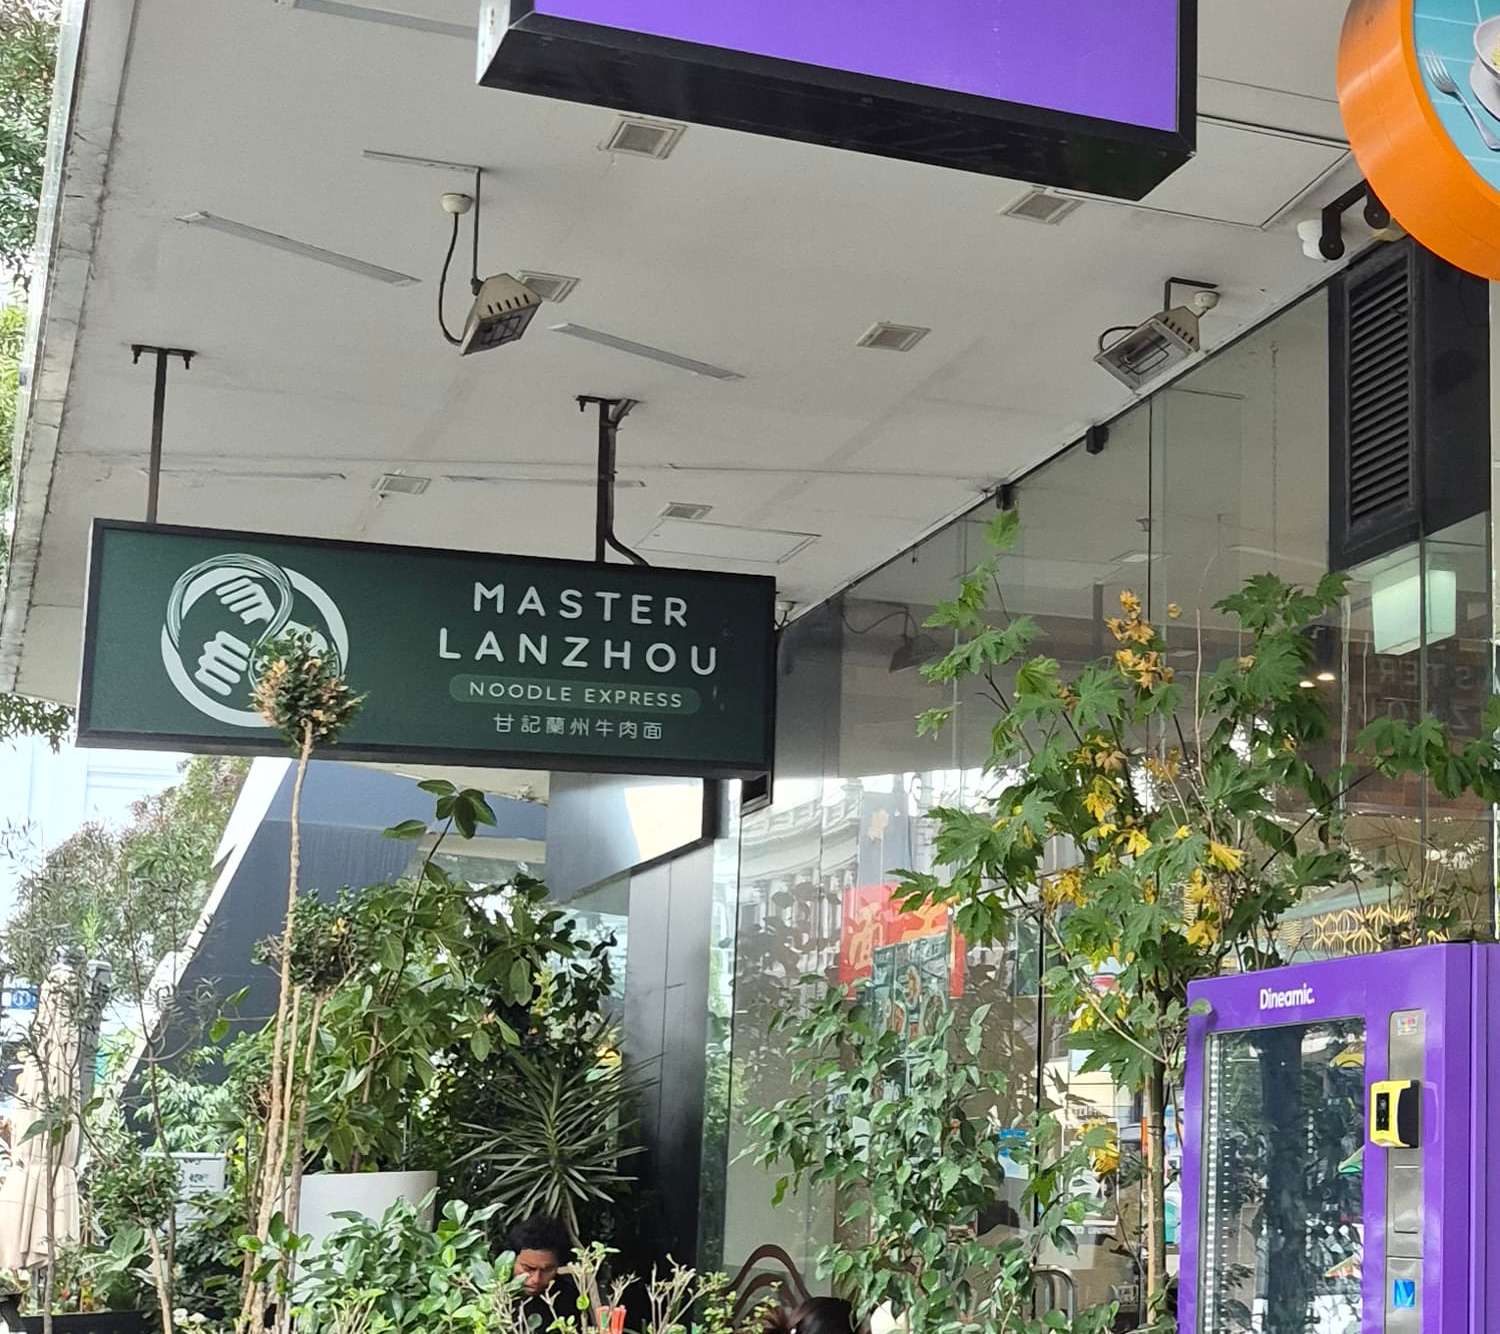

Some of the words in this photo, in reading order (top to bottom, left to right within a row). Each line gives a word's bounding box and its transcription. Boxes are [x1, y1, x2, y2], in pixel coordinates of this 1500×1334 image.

[473, 582, 687, 627] MASTER
[439, 628, 717, 676] LANZHOU
[469, 681, 572, 702] NOODLE
[584, 688, 683, 708] EXPRESS
[493, 713, 663, 740] 甘記蘭州牛肉面
[1259, 983, 1316, 1010] Dineamic.
